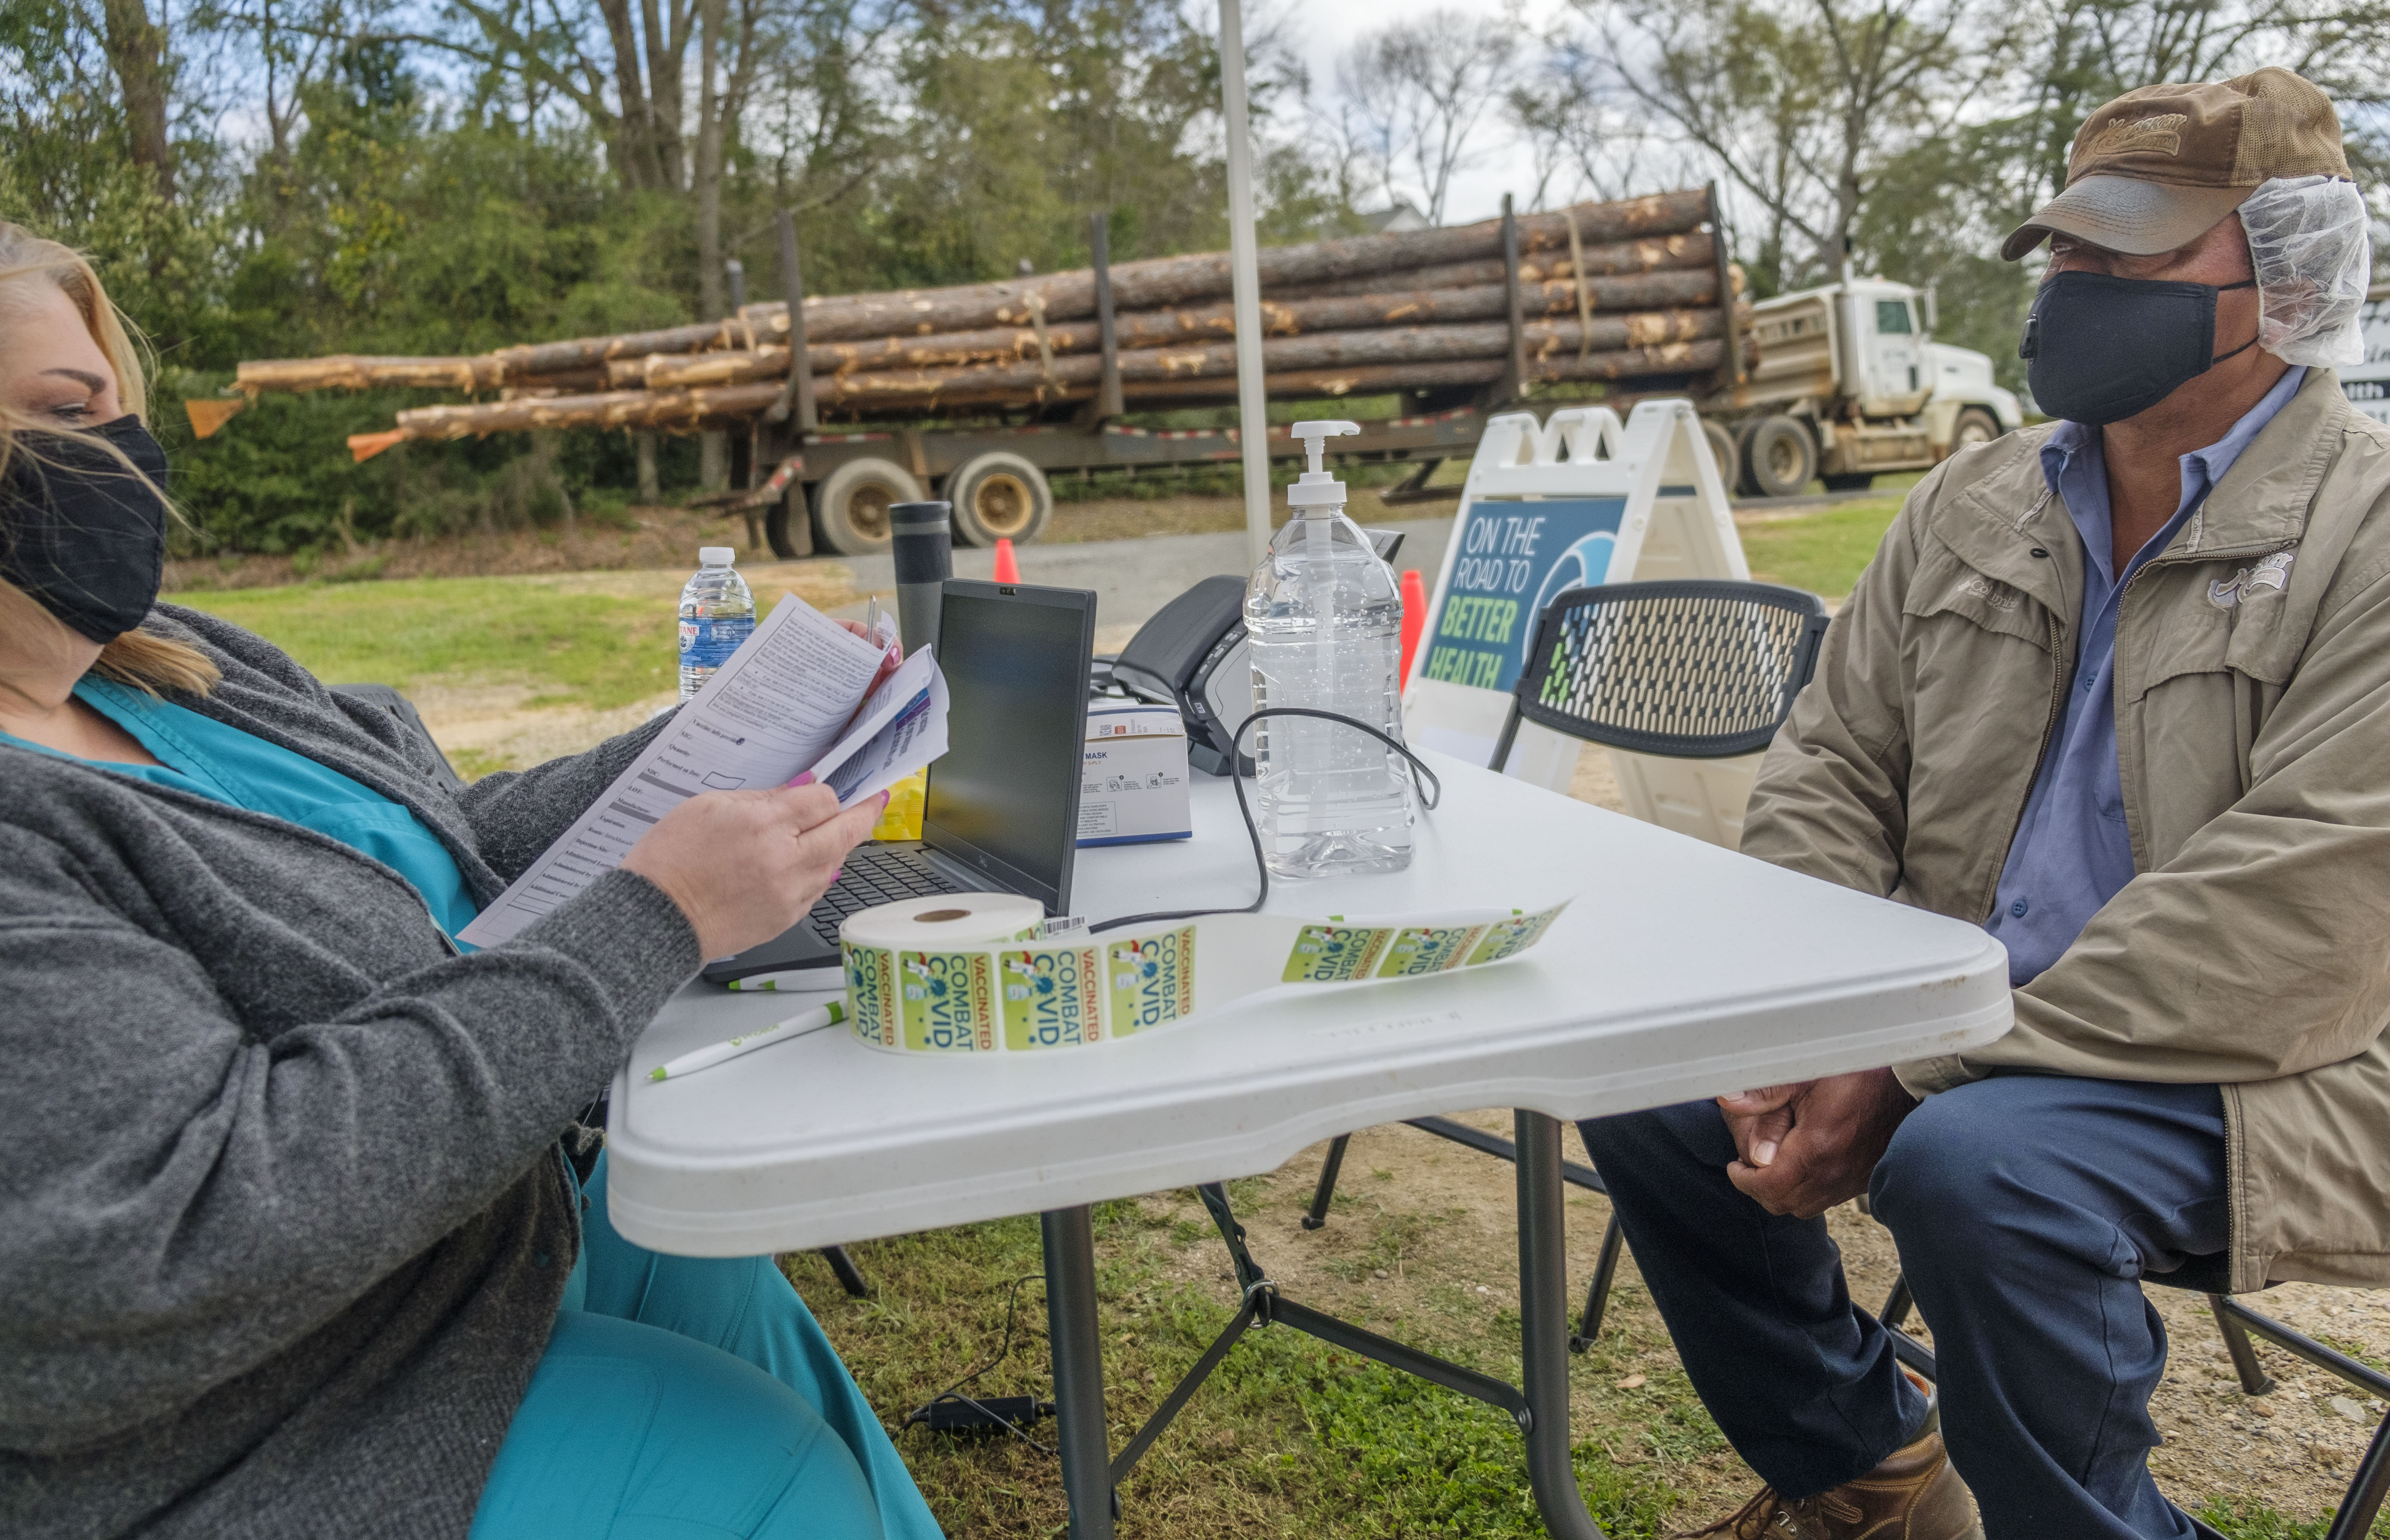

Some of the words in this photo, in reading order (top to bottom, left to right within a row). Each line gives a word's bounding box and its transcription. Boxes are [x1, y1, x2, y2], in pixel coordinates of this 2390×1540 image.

[1454, 558, 1503, 590] ROAD
[1504, 560, 1530, 592] TO
[1467, 517, 1501, 553] ON
[1501, 517, 1546, 555] THE
[1440, 595, 1518, 643] BETTER
[1427, 646, 1503, 689] HEALTH
[1161, 933, 1177, 1020] COMBAT
[1180, 928, 1190, 1015] VACCINATED
[1334, 929, 1371, 981] COMBAT
[1355, 930, 1389, 980] VACCINATED
[1428, 928, 1467, 972] COMBAT
[864, 950, 882, 1045] COMBAT
[880, 953, 894, 1045] VACCINATED
[950, 955, 973, 1051] COMBAT
[974, 955, 991, 1050] VACCINATED
[1057, 951, 1081, 1045] COMBAT
[1082, 949, 1099, 1042] VACCINATED
